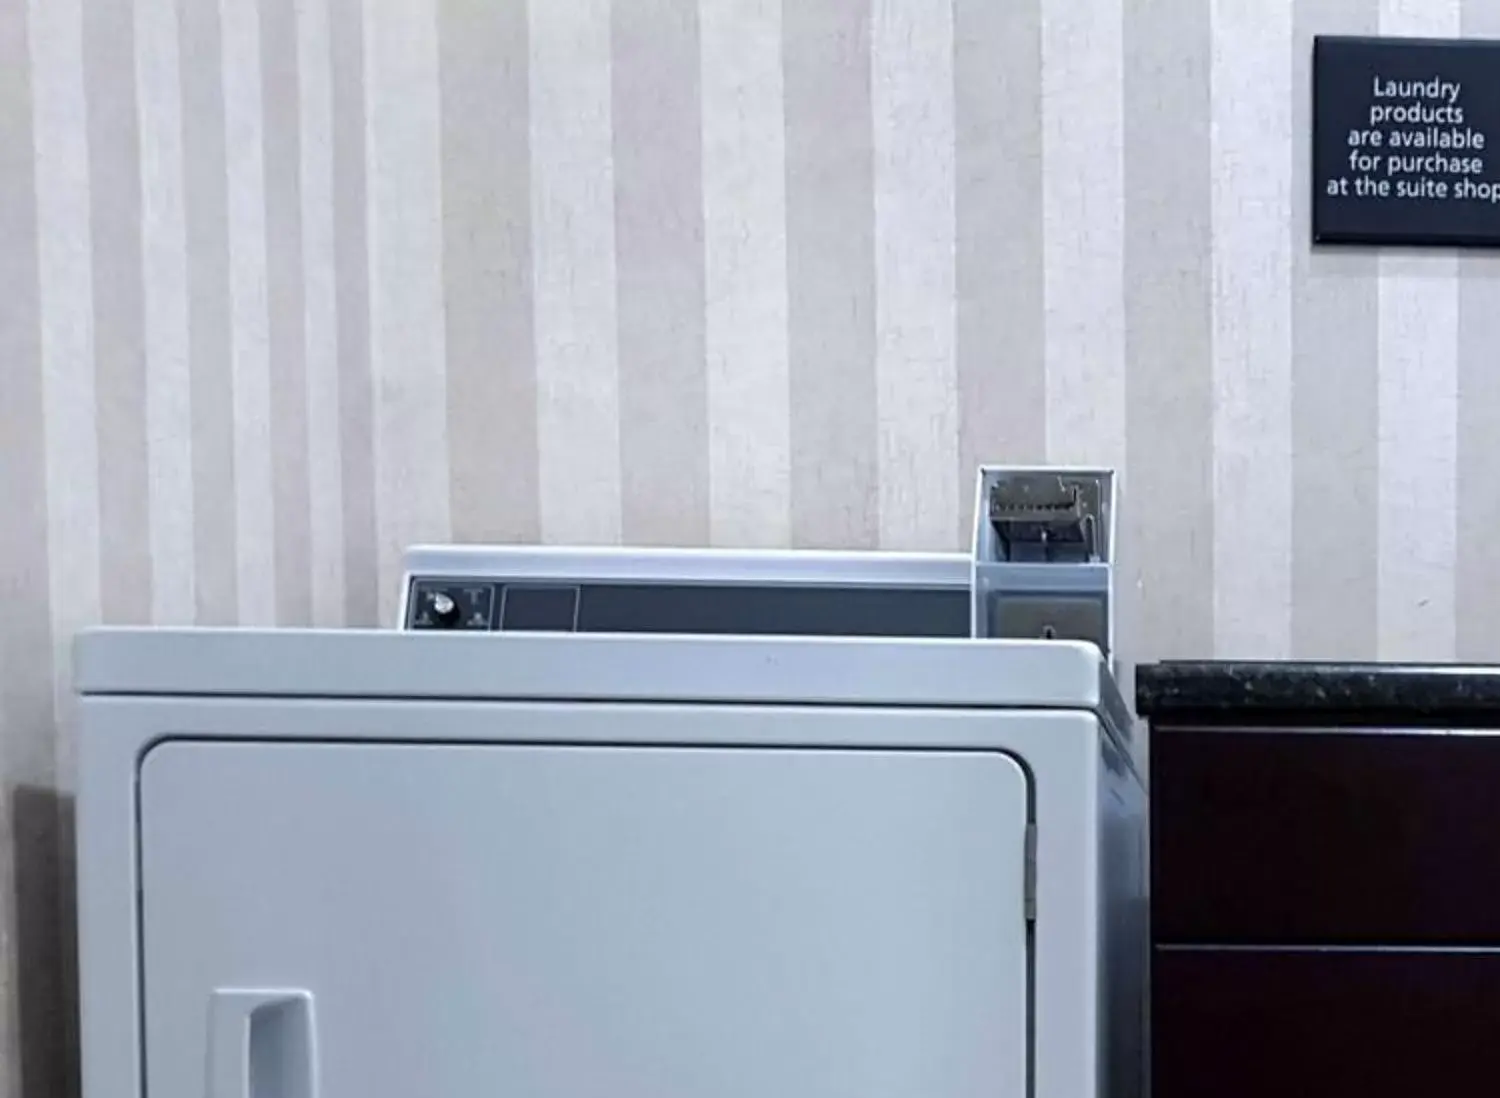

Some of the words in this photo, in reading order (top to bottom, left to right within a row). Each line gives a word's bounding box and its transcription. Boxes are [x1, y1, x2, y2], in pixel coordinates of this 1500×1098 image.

[1373, 76, 1461, 103] Laundry
[1370, 102, 1464, 126] products
[1348, 129, 1383, 147] are
[1389, 128, 1485, 150] available
[1349, 150, 1381, 172] for
[1387, 152, 1484, 177] purchase
[1327, 178, 1349, 196] at
[1355, 176, 1391, 197] the
[1396, 177, 1448, 198] suite
